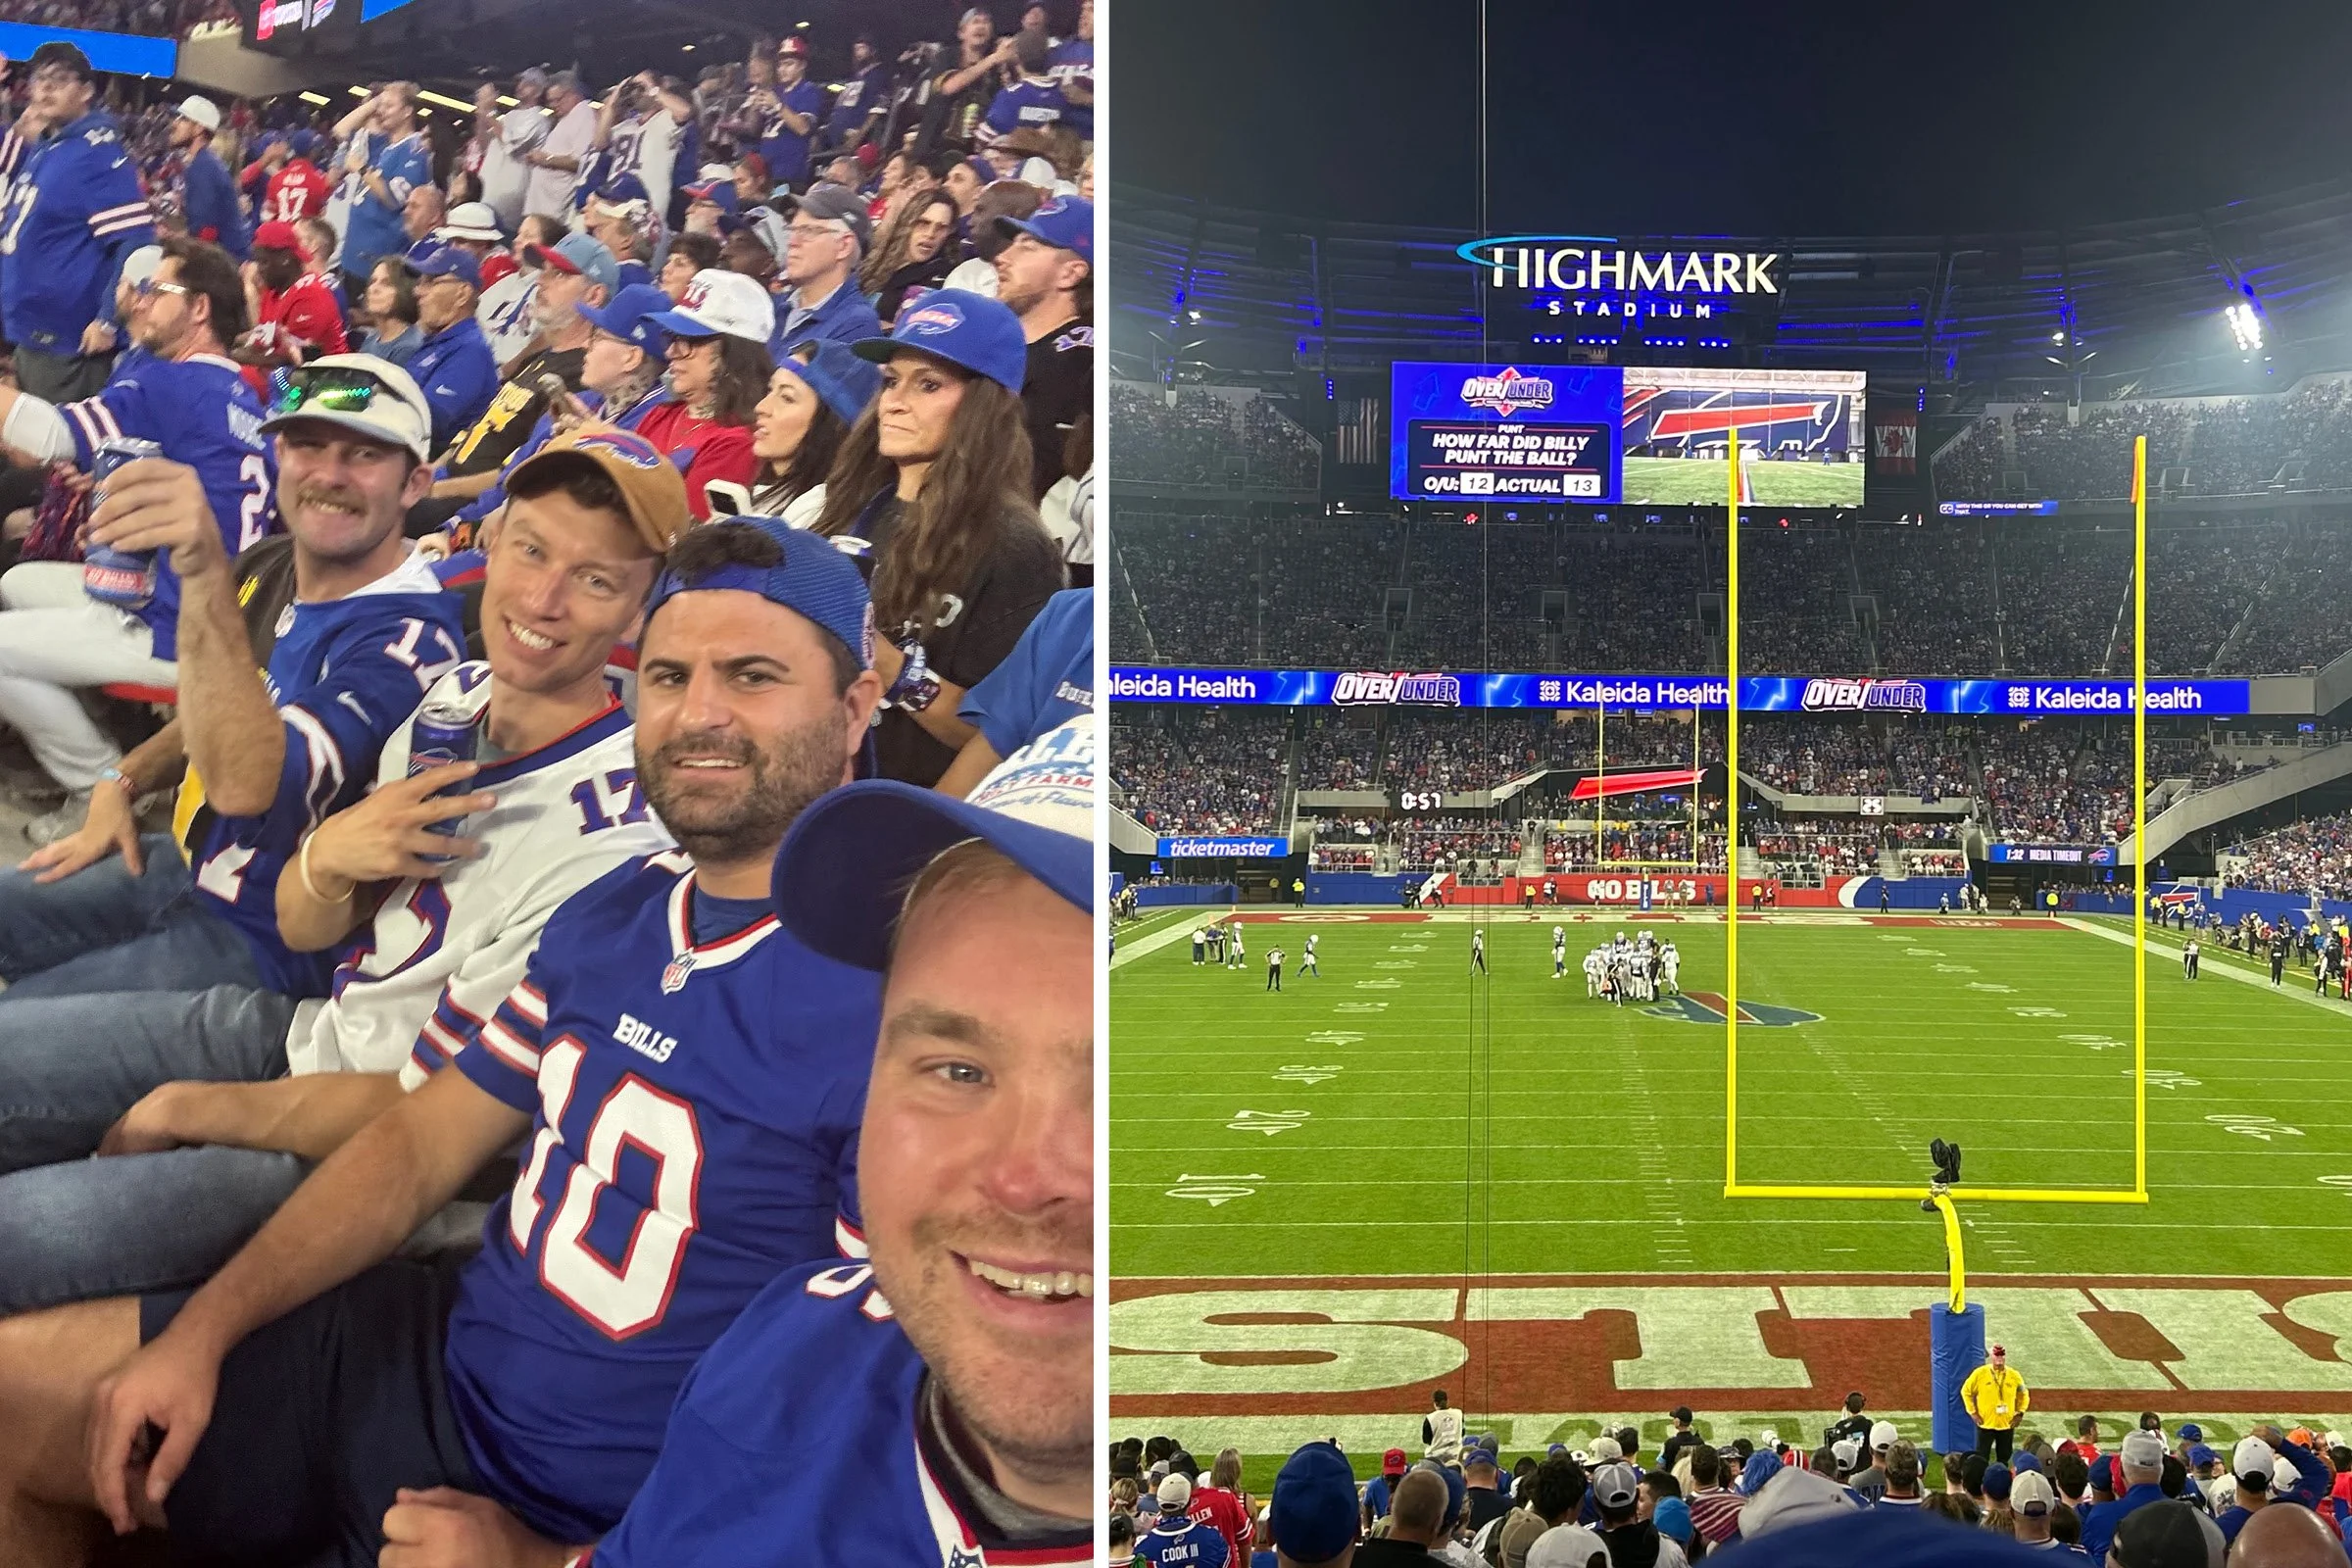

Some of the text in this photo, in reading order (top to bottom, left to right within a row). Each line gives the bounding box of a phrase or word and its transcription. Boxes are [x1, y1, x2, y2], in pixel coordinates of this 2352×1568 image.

[1494, 247, 1778, 294] HIGHMARK
[1549, 301, 1710, 319] STADIUM
[1497, 424, 1525, 434] PUNT
[1432, 433, 1590, 451] HOW FAR DID BILLY
[1445, 450, 1578, 466] PUNT THE BALL?
[1424, 477, 1592, 494] O/U: 12 ACTUAL 13
[383, 616, 461, 694] 17
[1178, 675, 1255, 699] Health
[1568, 680, 1729, 705] Kaleida Health
[2035, 687, 2122, 710] Kaleida
[570, 767, 651, 835] 17
[1401, 792, 1442, 810] 0:57
[1170, 840, 1275, 857] ticketmaster
[2006, 850, 2082, 862] 1:32 MEDIA TIMEOUT
[1588, 879, 1622, 900] GO
[612, 1012, 678, 1063] BILLS
[510, 1032, 704, 1343] 10
[1162, 1545, 1189, 1562] COOK
